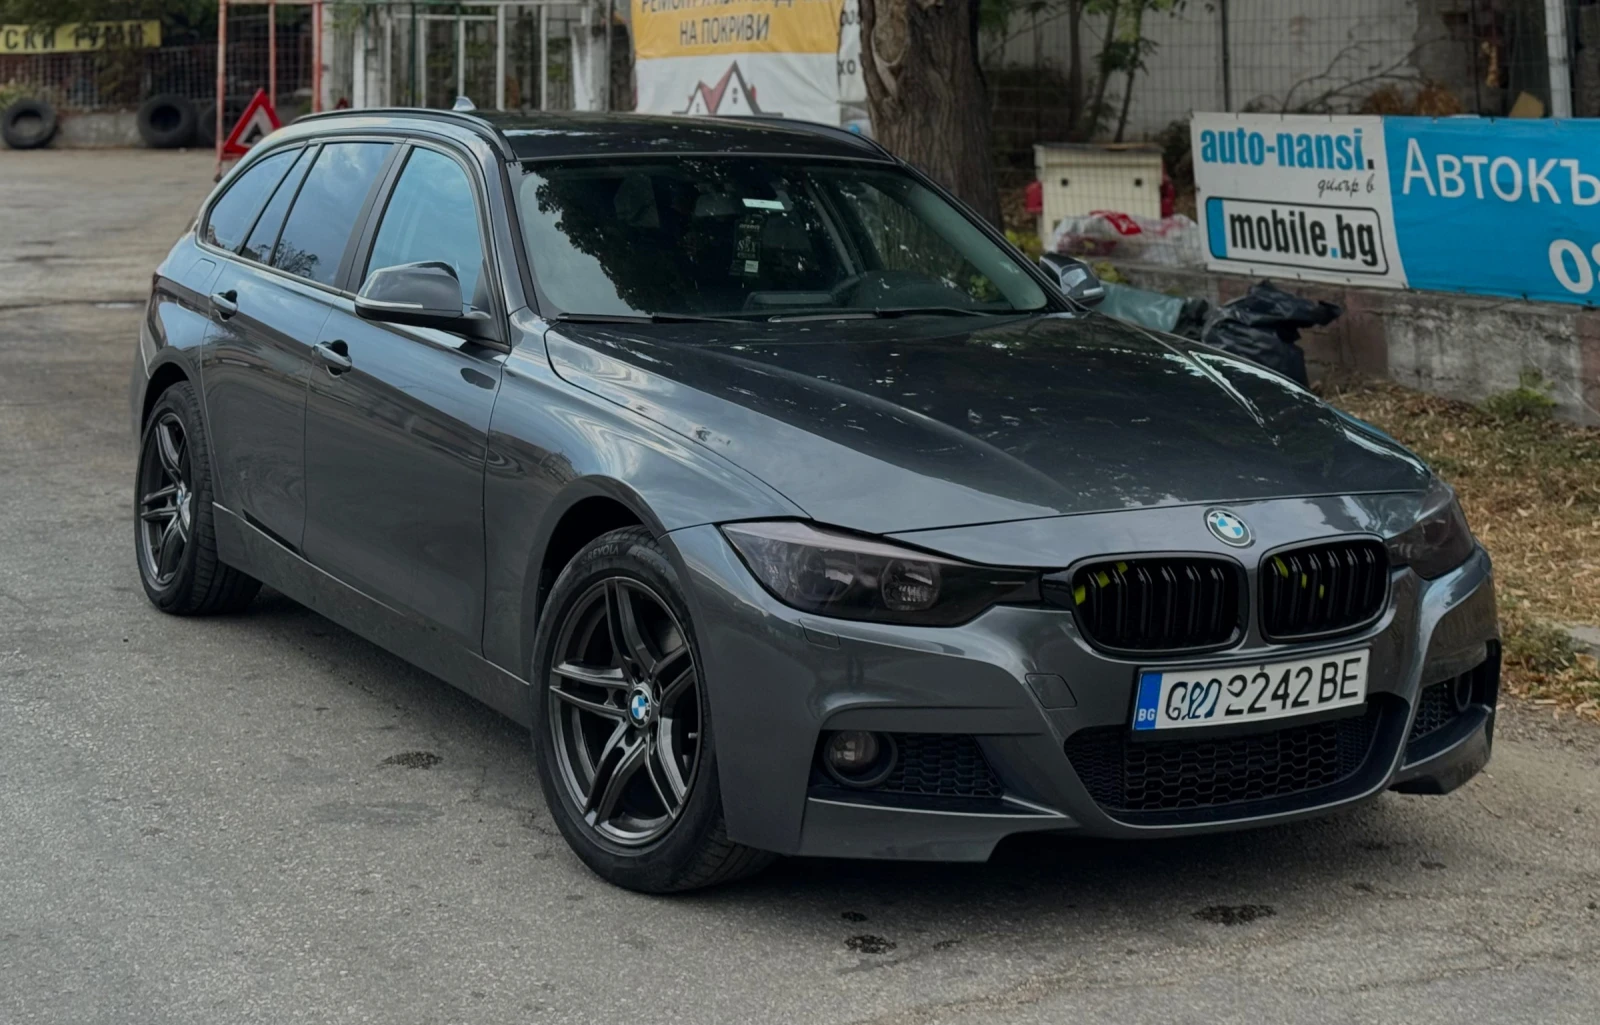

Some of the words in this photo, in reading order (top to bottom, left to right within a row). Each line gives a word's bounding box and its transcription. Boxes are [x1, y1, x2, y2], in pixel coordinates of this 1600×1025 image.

[0, 25, 55, 50] СКИ
[680, 19, 698, 45] НА
[701, 14, 770, 45] ПОКРИВИ
[1229, 208, 1379, 268] mobile.bg
[1548, 239, 1600, 294] 0
[1137, 708, 1156, 723] BG
